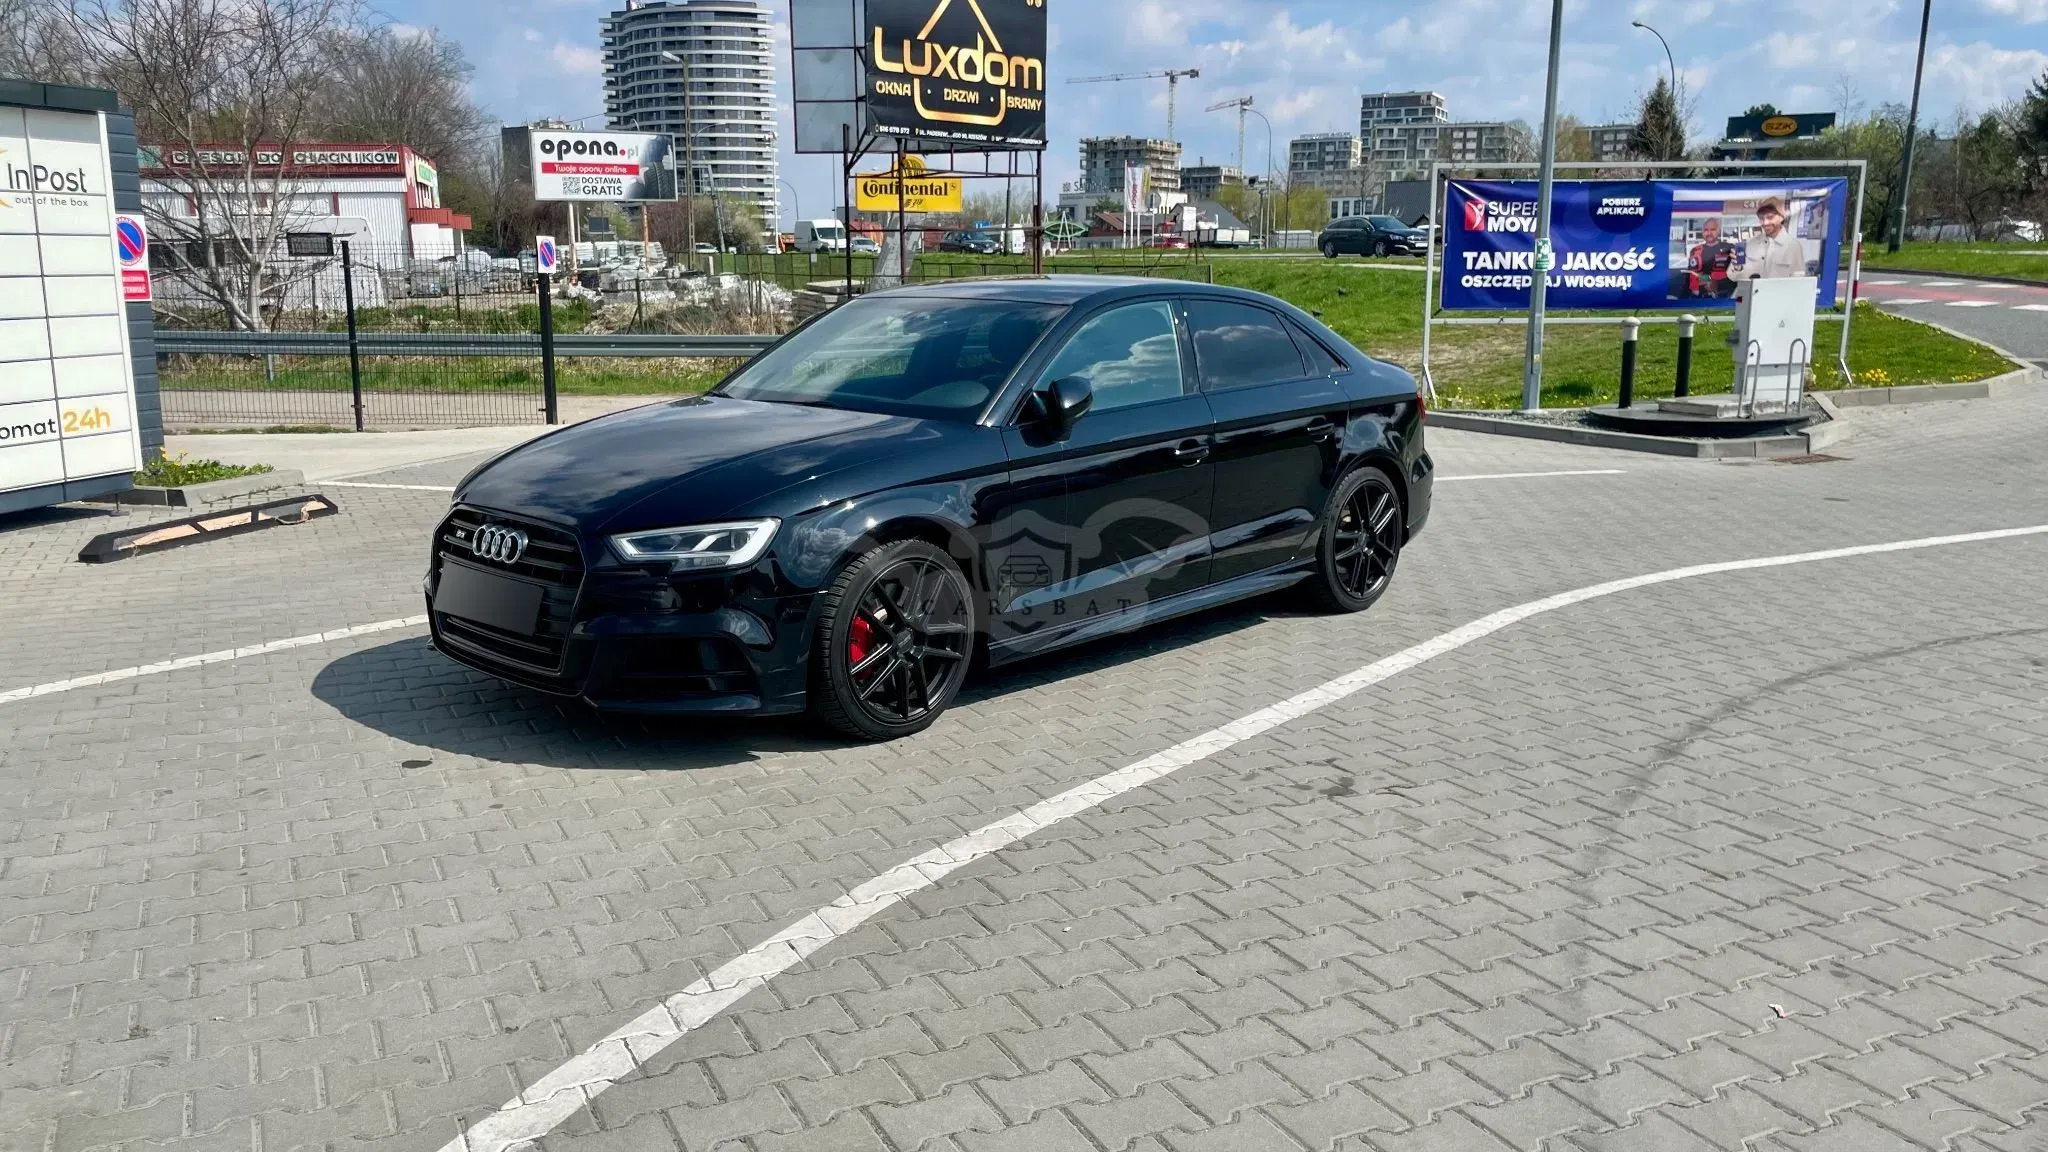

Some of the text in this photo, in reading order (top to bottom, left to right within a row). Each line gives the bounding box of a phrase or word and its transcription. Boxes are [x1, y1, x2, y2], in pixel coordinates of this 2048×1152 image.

[874, 26, 1043, 92] Luxdom
[875, 80, 1042, 112] OKNA DRZWI BRAMY
[554, 164, 577, 174] Twoje
[579, 166, 602, 175] opony
[7, 163, 88, 193] InPost
[581, 176, 622, 185] DOSTAWA
[582, 185, 623, 196] GRATIS
[863, 180, 948, 197] Continental
[37, 197, 47, 205] of
[50, 198, 67, 206] the
[70, 198, 89, 207] box
[1602, 198, 1641, 206] POBIERZ
[1596, 207, 1645, 216] APLIKACJĘ
[1562, 247, 1656, 271] JAKOŚĆ
[1461, 275, 1632, 290] OSZCZĘDAJ WIOSNĄ!
[63, 407, 111, 433] 24h
